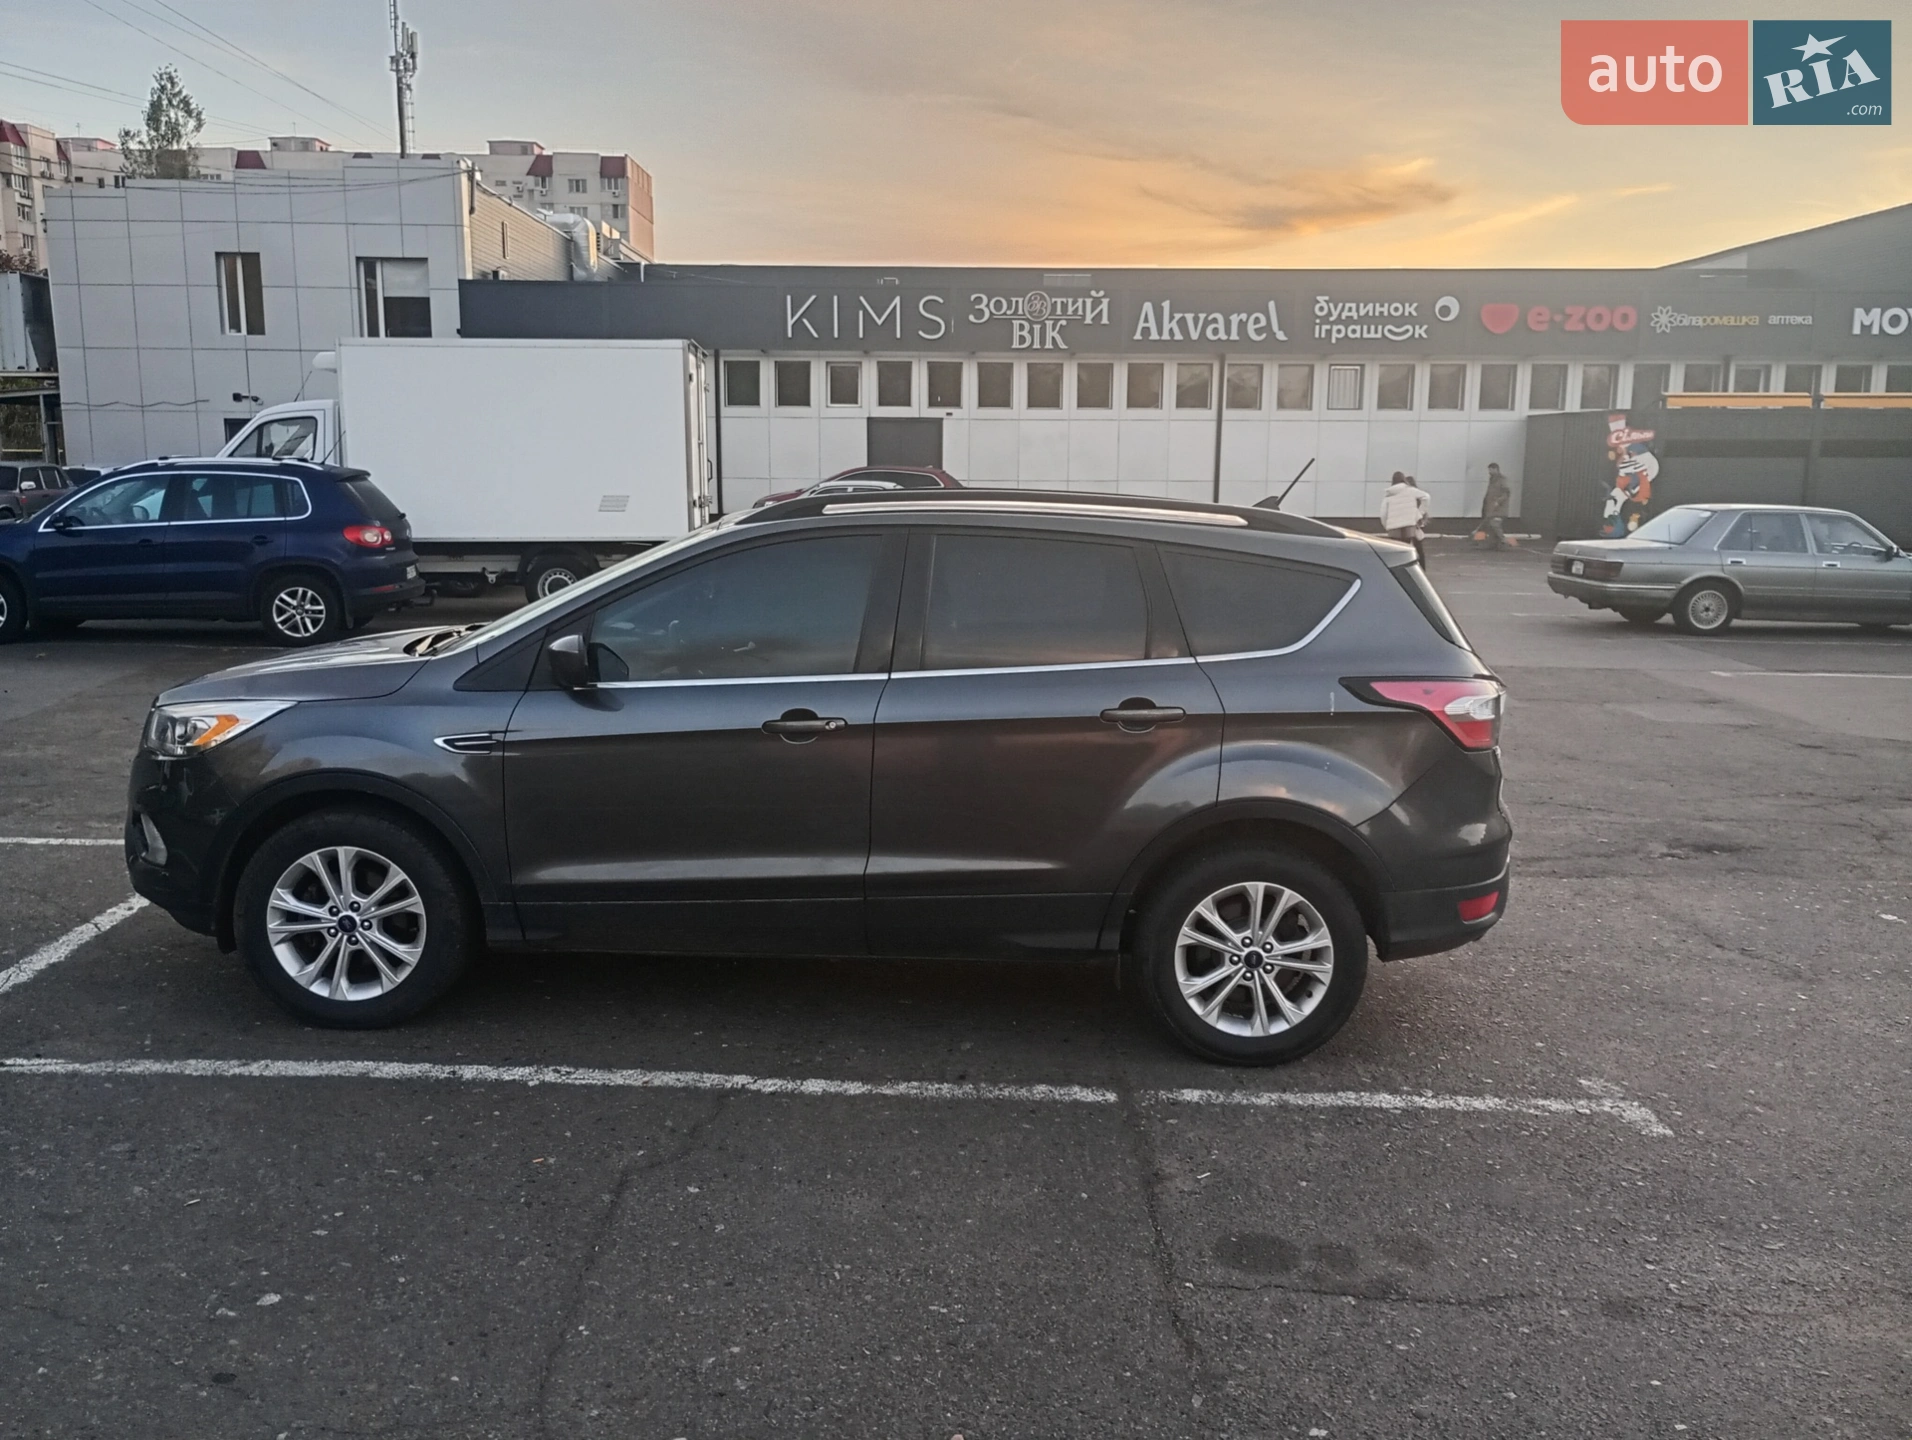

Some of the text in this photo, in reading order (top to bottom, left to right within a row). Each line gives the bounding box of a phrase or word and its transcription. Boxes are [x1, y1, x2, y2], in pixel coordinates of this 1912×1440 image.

[786, 295, 946, 340] KIMS
[1133, 300, 1289, 341] Akvarel
[1314, 295, 1418, 321] будинок
[1768, 315, 1813, 325] аптека
[1852, 307, 1912, 336] MO
